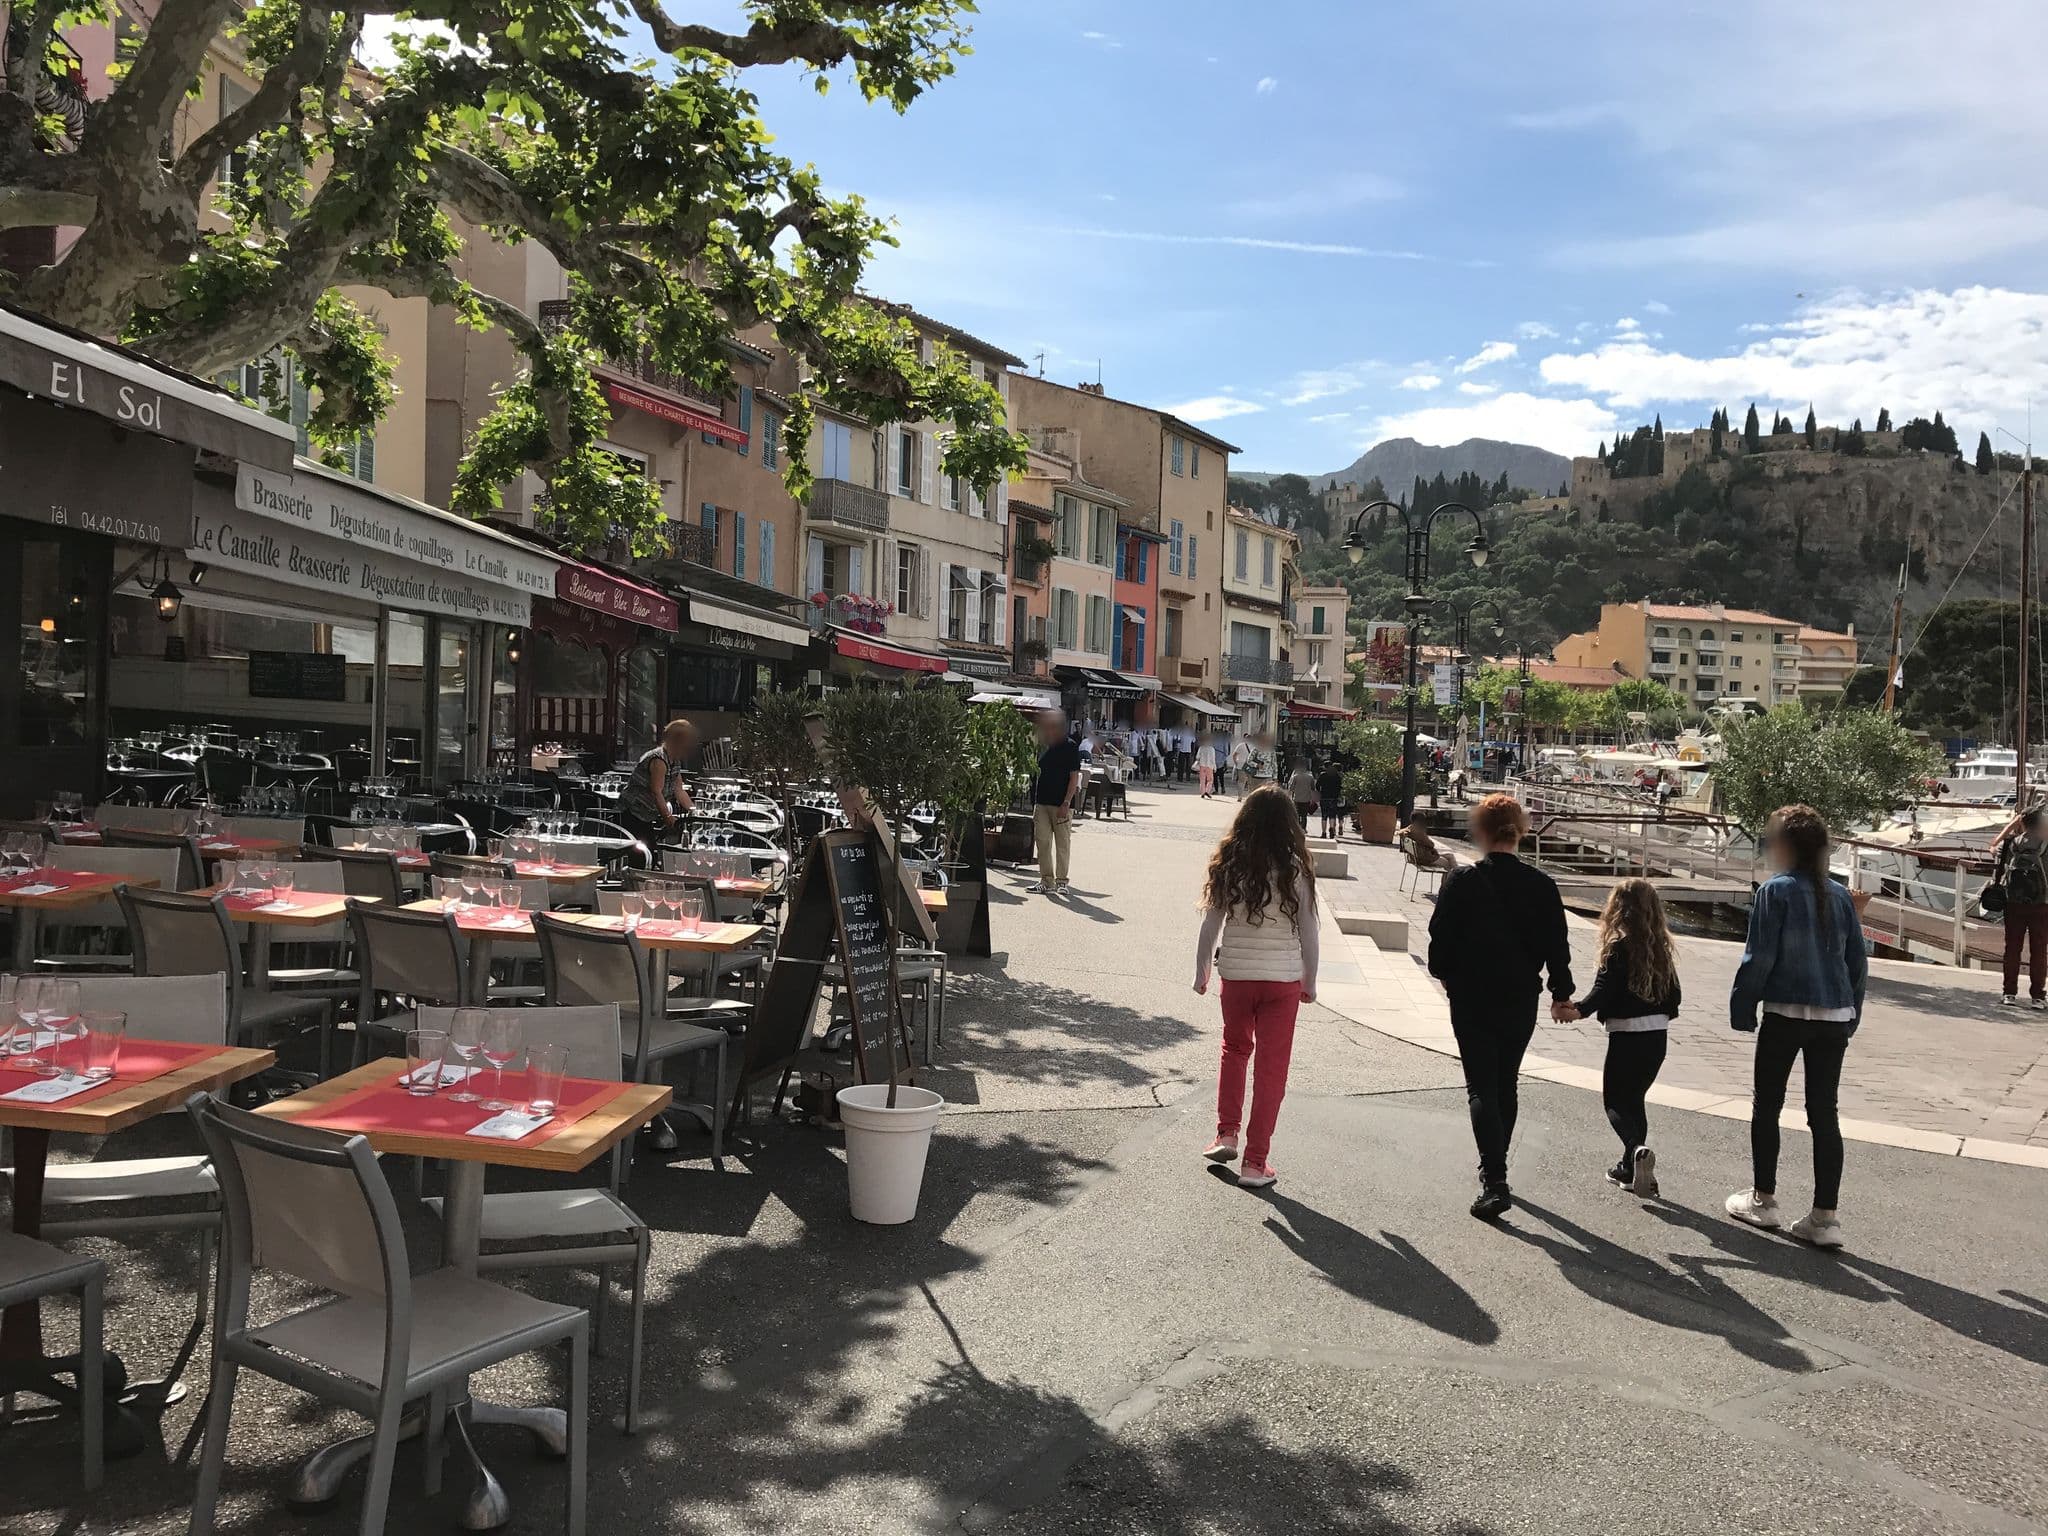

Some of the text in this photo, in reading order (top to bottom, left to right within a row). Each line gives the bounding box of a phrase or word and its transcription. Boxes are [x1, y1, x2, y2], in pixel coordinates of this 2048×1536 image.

[50, 361, 162, 430] El Sol
[619, 391, 643, 407] MEMBRE
[645, 401, 654, 411] DE
[655, 404, 662, 415] LA
[664, 408, 685, 423] CHARTE
[686, 417, 694, 427] DE
[695, 419, 702, 429] LA
[51, 505, 161, 542] Tél 04.42.01.76.10
[253, 478, 313, 521] Brasserie
[330, 504, 391, 545] Dégustation
[393, 527, 404, 549] de
[408, 536, 454, 566] coquillages
[465, 549, 476, 569] Le
[477, 553, 509, 579] Canaille
[193, 515, 213, 552] Le
[218, 524, 280, 569] Canaille
[288, 544, 351, 585] Brasserie
[360, 563, 425, 601] Dégustation
[428, 579, 441, 603] de
[441, 586, 490, 617] coquillages
[569, 572, 606, 605] Restaurant
[963, 663, 970, 672] LE
